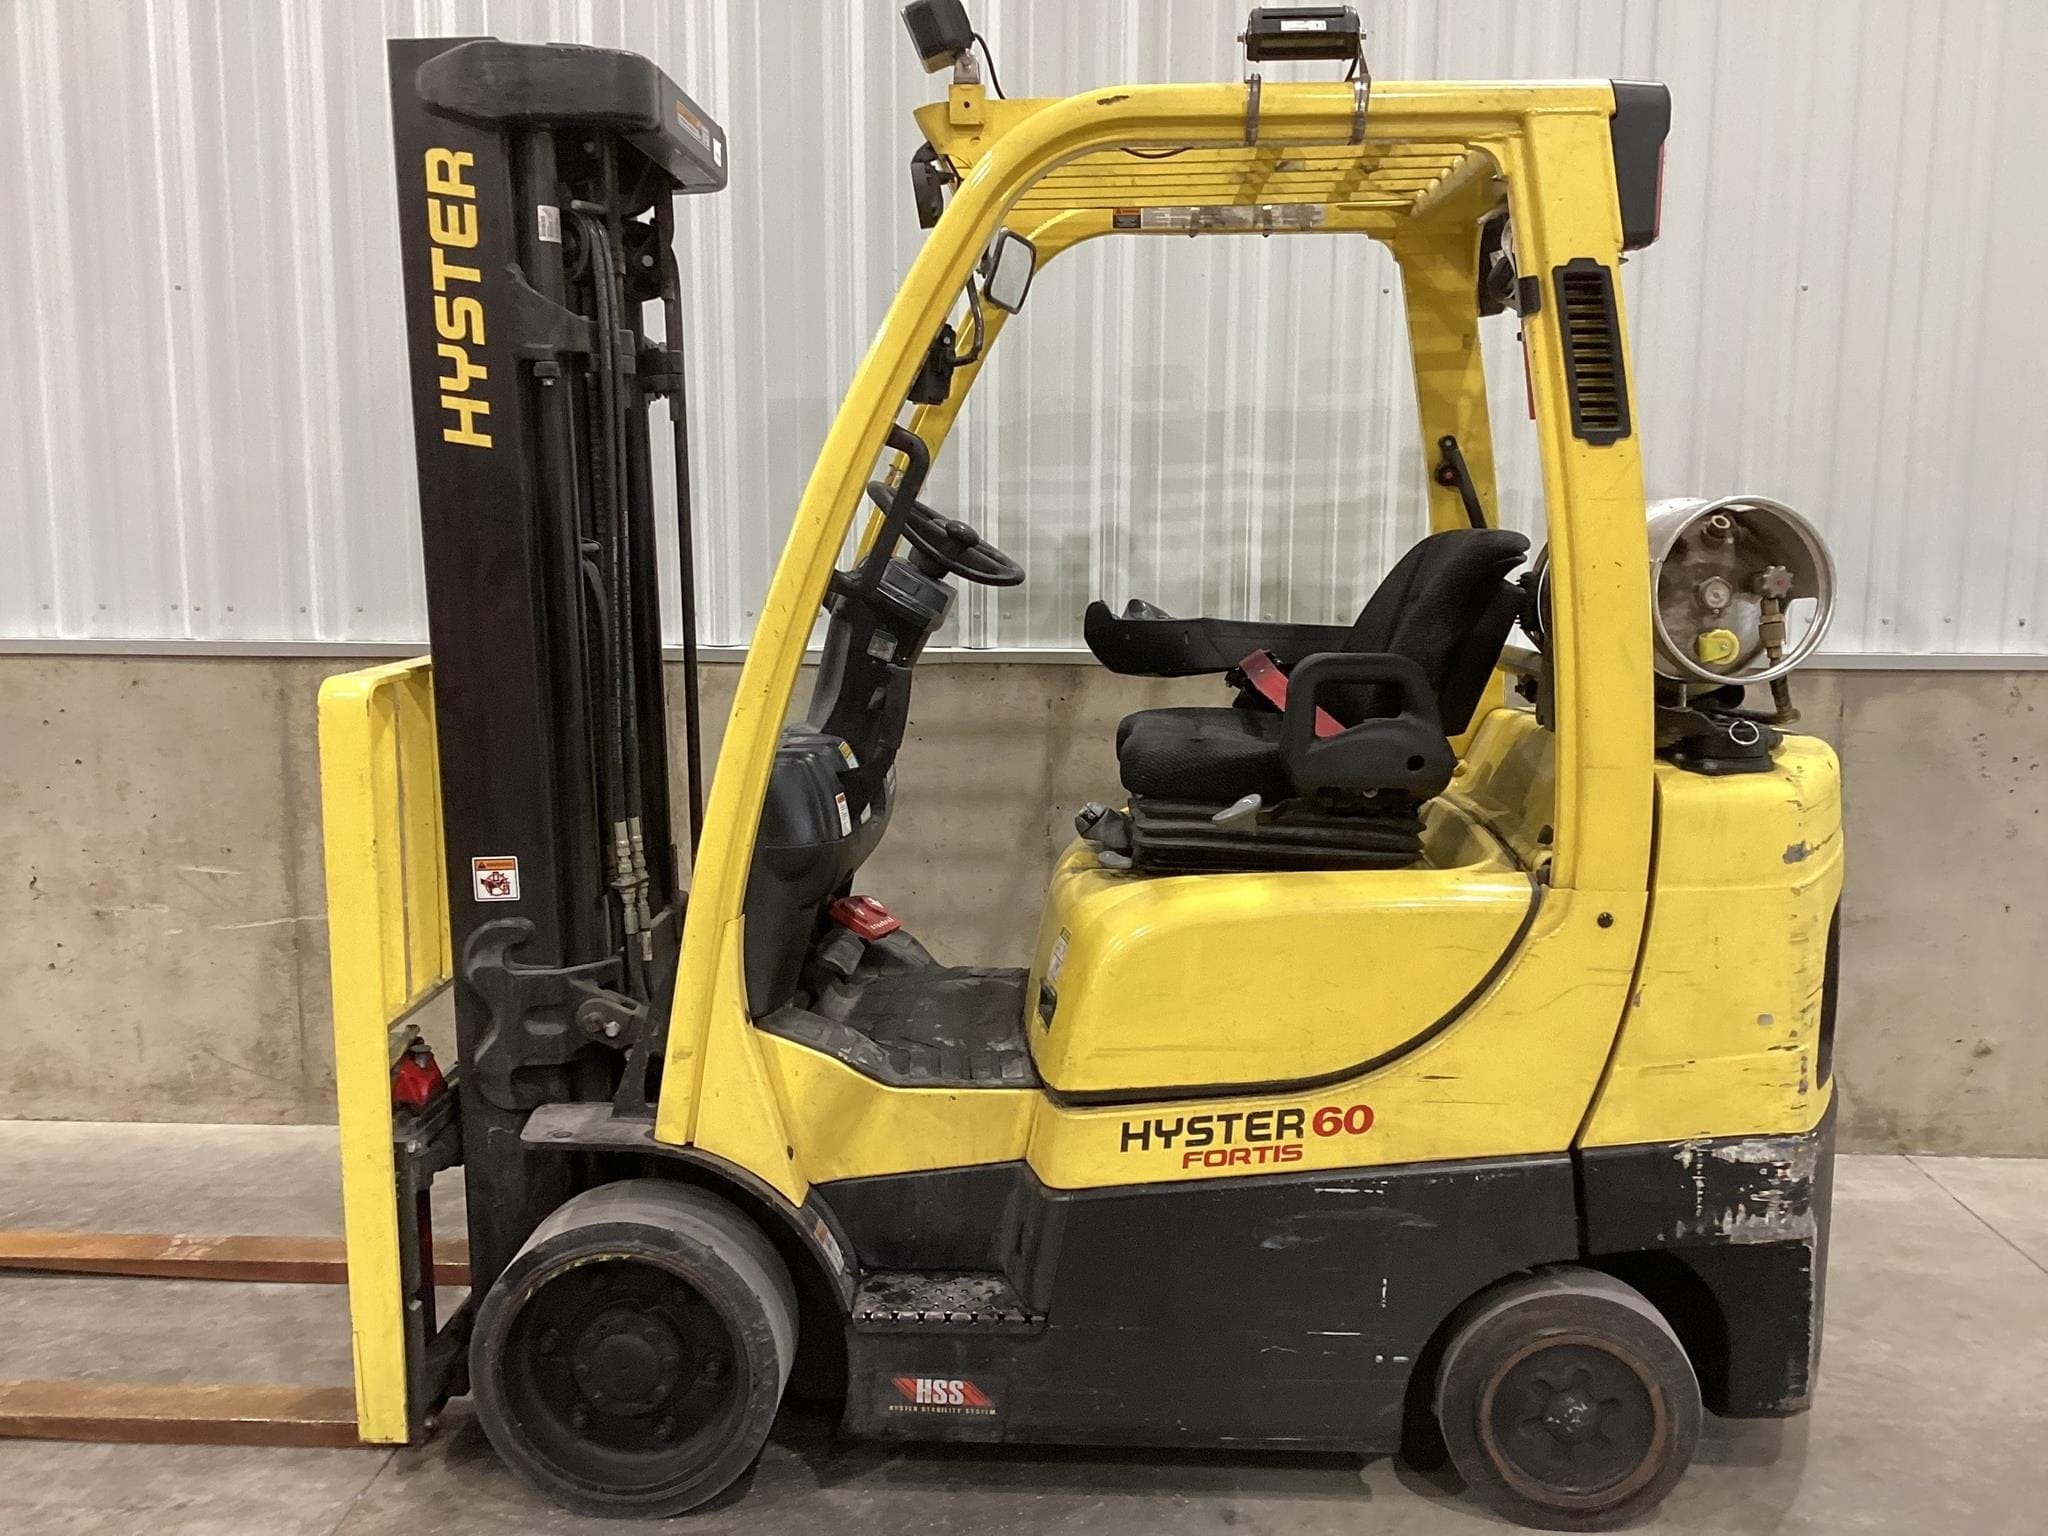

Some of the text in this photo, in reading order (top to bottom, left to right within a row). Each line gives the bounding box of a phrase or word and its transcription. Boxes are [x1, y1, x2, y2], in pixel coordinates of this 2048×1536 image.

[425, 147, 492, 447] HYSTER
[1121, 1104, 1374, 1152] HYSTER 60
[1182, 1144, 1303, 1169] FORTIS
[916, 1379, 964, 1404] HSS
